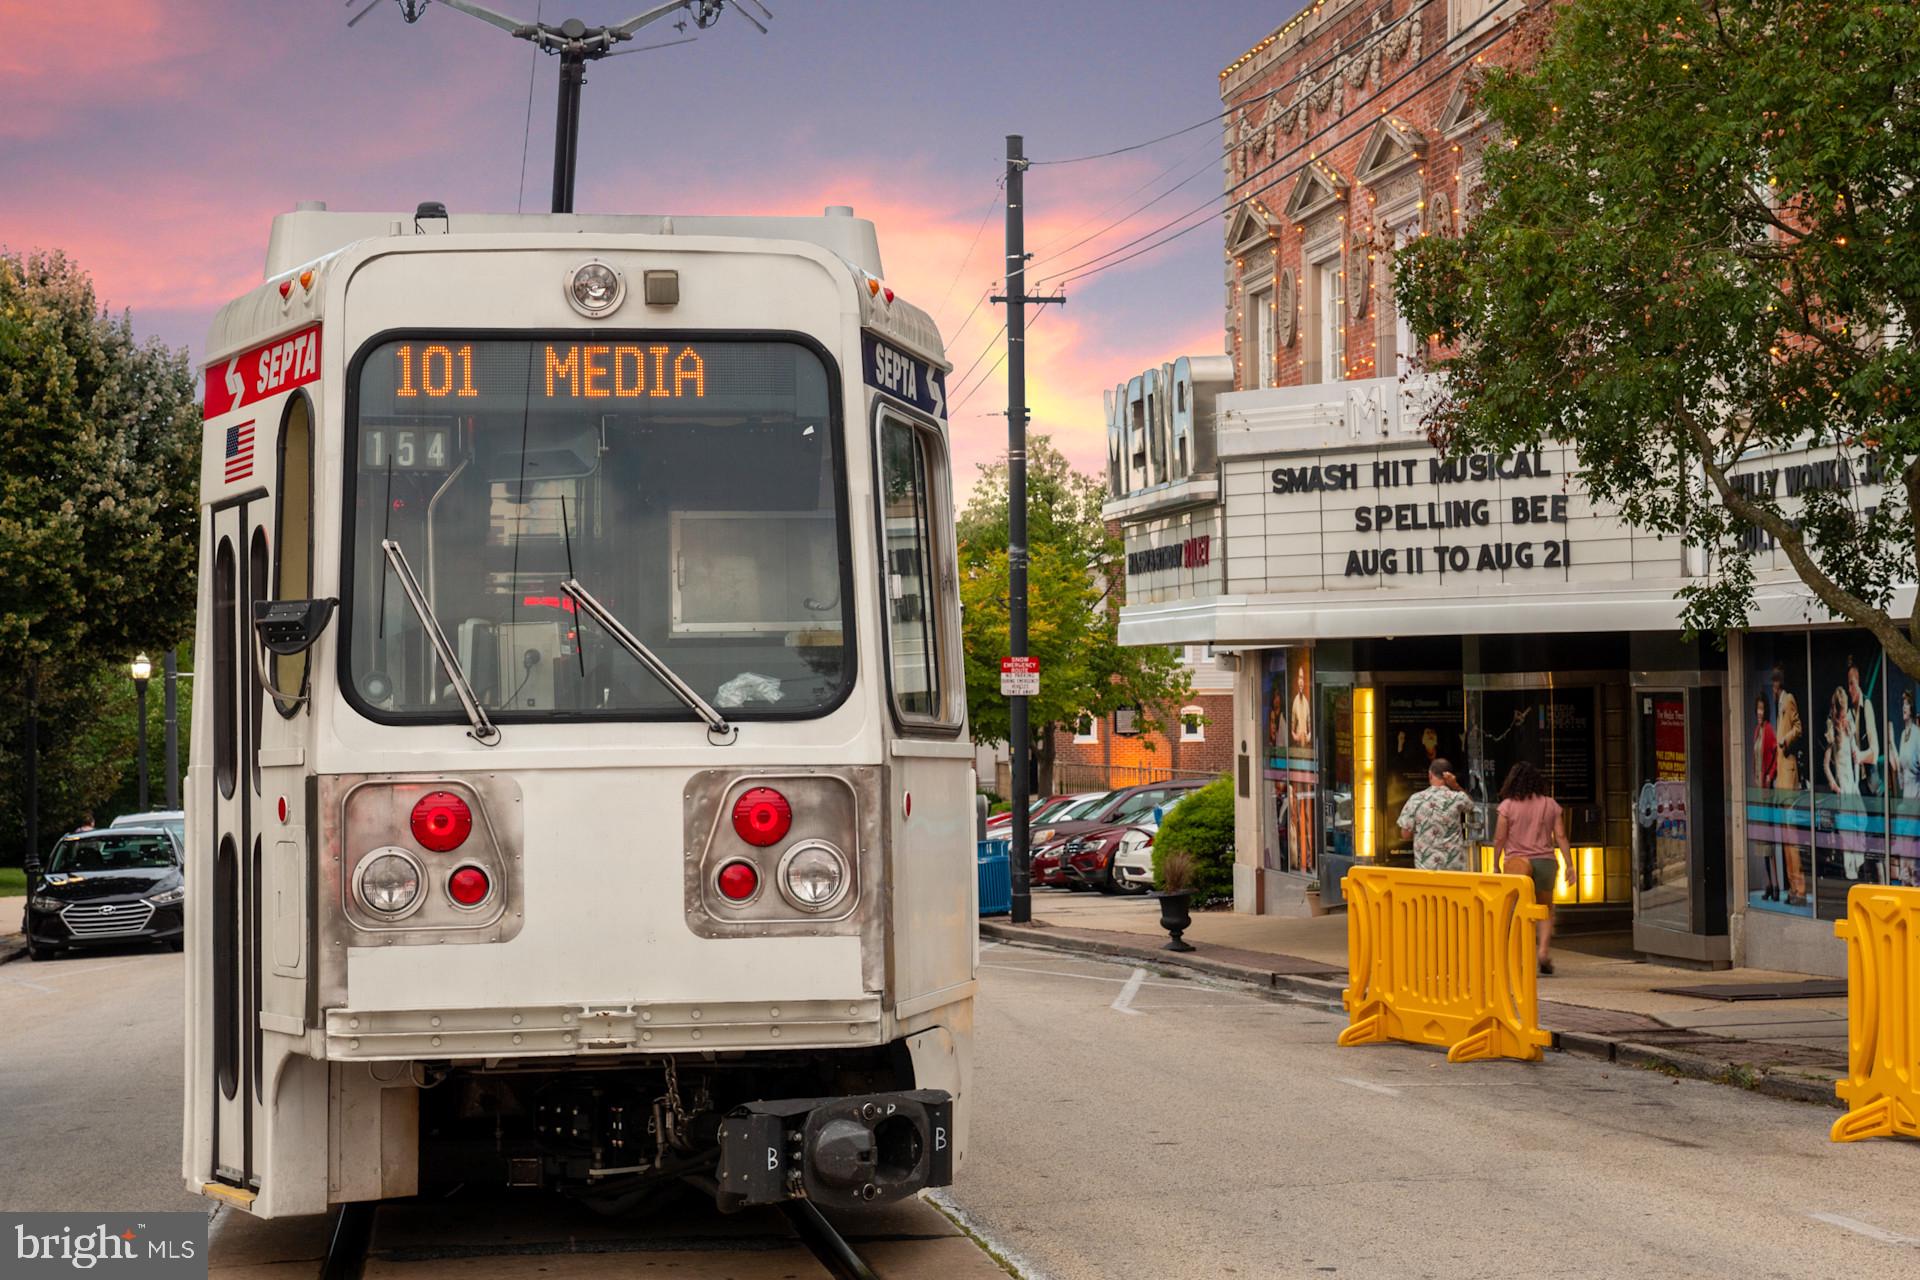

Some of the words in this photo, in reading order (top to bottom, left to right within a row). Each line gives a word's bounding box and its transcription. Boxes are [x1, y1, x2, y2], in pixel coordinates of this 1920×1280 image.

[256, 331, 317, 394] SEPTA
[396, 345, 479, 397] 101
[544, 345, 704, 397] MEDIA
[875, 342, 918, 402] SEPTA
[1103, 356, 1195, 498] MEDIA
[372, 430, 446, 468] 154
[1271, 463, 1358, 495] SMASH
[1372, 458, 1418, 488] HIT
[1429, 450, 1552, 484] MUSICAL
[1784, 457, 1852, 497] WONKA
[1354, 499, 1490, 532] SPELLING
[1511, 494, 1570, 525] BEE
[1344, 548, 1398, 577] AUG
[1433, 545, 1470, 573] TO
[1476, 541, 1534, 571] AUG
[1543, 539, 1571, 568] 21
[767, 1147, 779, 1171] B
[935, 1127, 947, 1151] B
